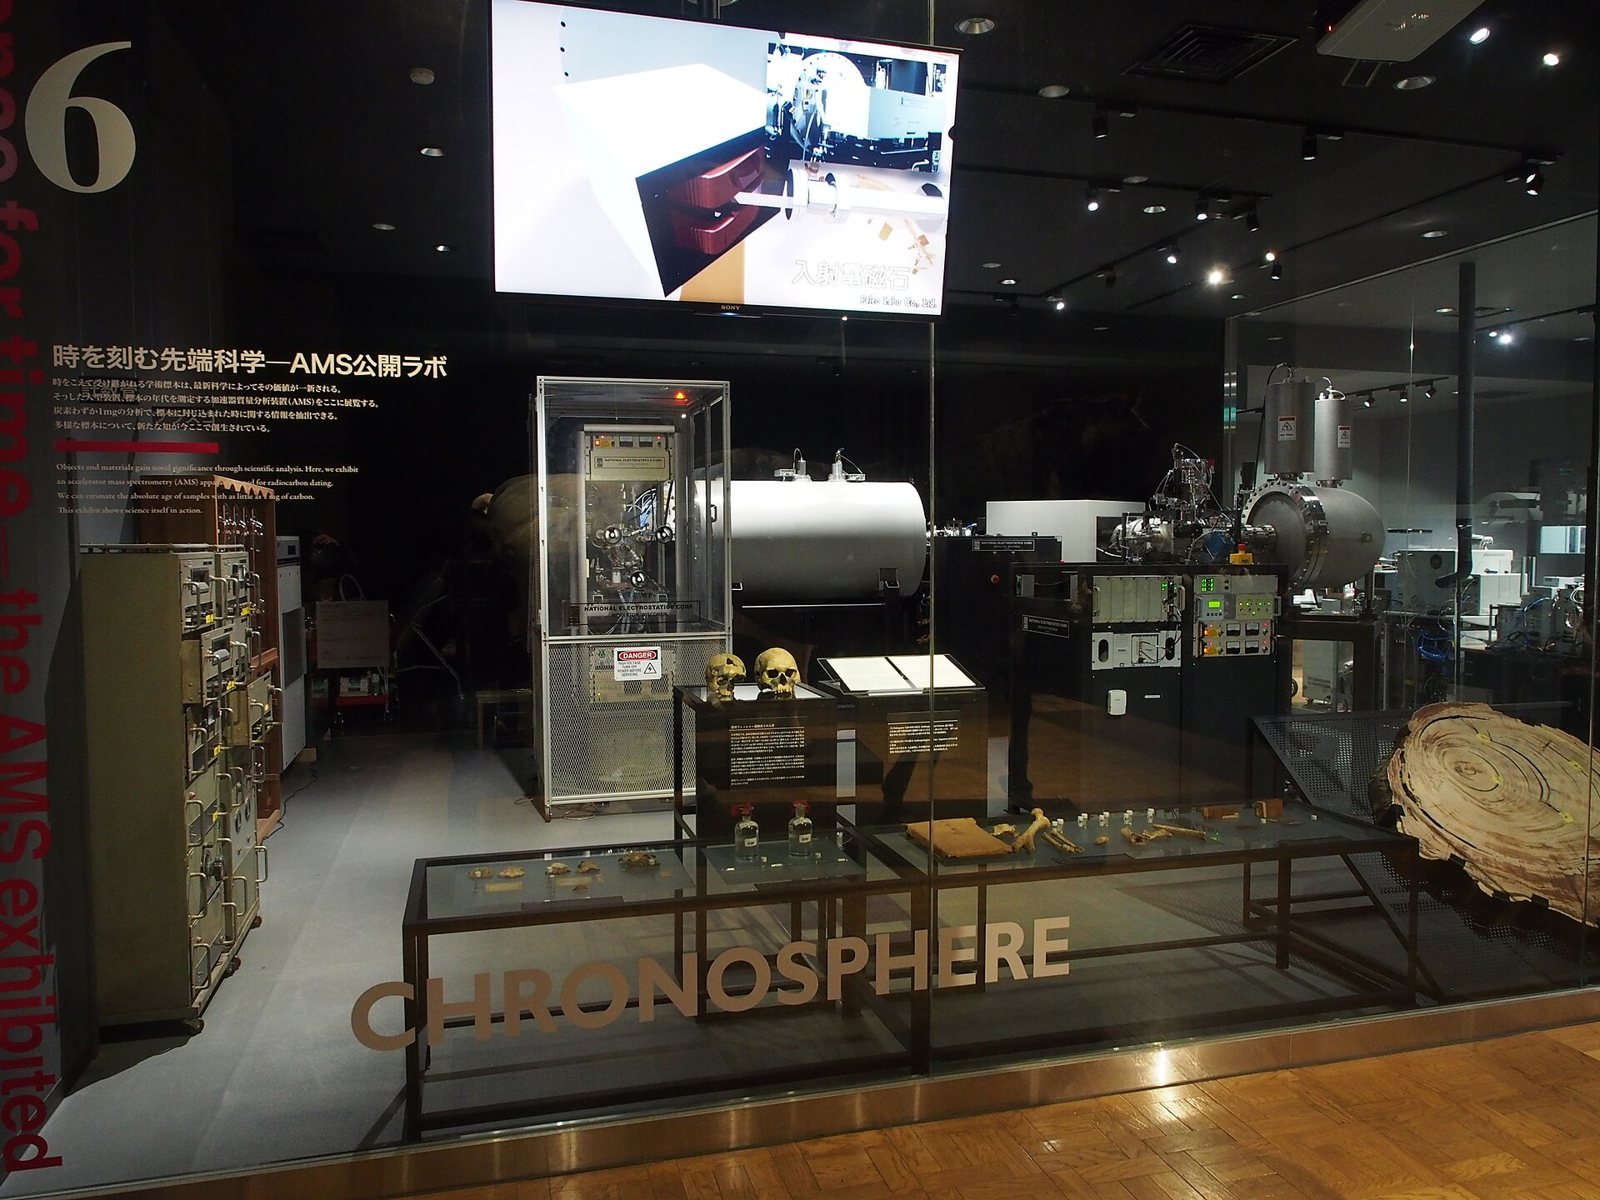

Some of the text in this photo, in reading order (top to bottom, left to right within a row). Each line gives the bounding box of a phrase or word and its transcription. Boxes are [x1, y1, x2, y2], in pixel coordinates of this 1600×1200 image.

[25, 41, 136, 193] 6
[792, 259, 910, 290] 入射電磁石
[56, 463, 84, 472] Objects
[135, 465, 151, 473] gain
[173, 464, 213, 474] significance
[215, 465, 243, 473] through
[276, 466, 303, 474] analysis.
[126, 479, 172, 487] spectrometry
[174, 478, 199, 486] (AMS)
[310, 480, 333, 488] dating.
[183, 493, 210, 501] samples
[151, 506, 169, 514] itself
[0, 589, 43, 695] the
[0, 711, 52, 864] AMS
[351, 916, 1071, 1051] CHRONOSPHERE
[0, 879, 63, 1173] exhibited
